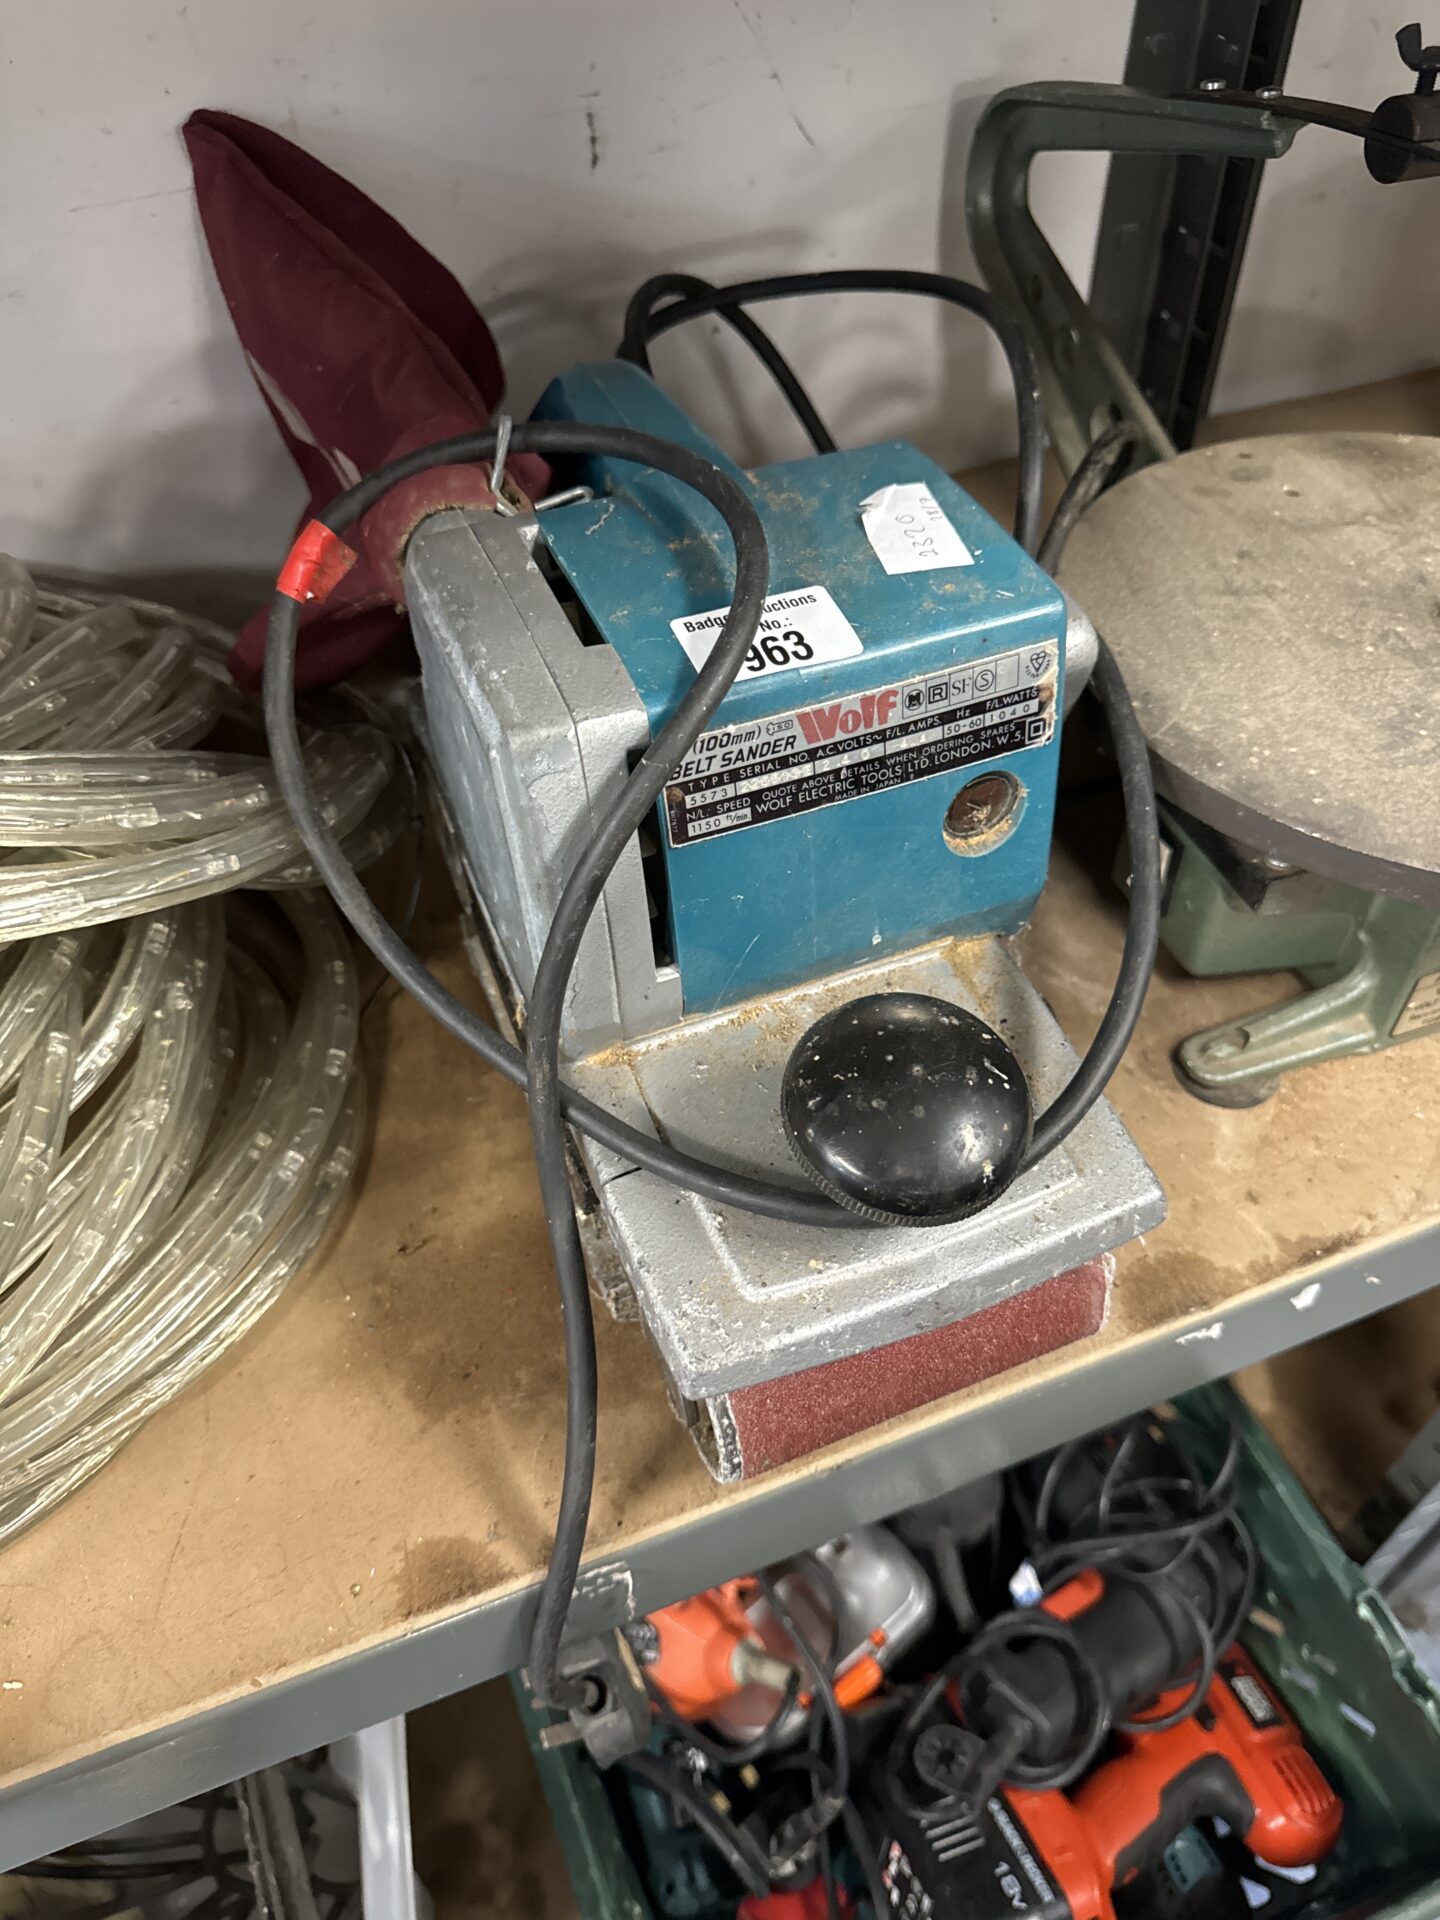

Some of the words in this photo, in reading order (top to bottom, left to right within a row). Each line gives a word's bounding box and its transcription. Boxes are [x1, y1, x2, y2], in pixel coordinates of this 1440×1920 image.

[763, 593, 817, 613] uctions
[743, 630, 814, 672] 963
[796, 689, 899, 745] Wolf
[956, 707, 971, 719] Hz
[989, 704, 1030, 723] 1040
[946, 718, 982, 735] 50-60
[692, 725, 762, 755] (100mm)
[670, 754, 716, 781] BELT
[720, 735, 797, 768] SANDER
[739, 759, 781, 779] SERIAL
[788, 752, 811, 765] NO.
[762, 785, 797, 801] QUOTE
[802, 773, 835, 790] ABOVE
[841, 761, 880, 779] DETAILS
[886, 751, 917, 766] WHEN
[922, 734, 974, 756] ORDERING
[980, 722, 1016, 740] SPARES
[688, 773, 731, 792] TYPE
[755, 796, 793, 813] WOLF
[799, 778, 855, 803] ELECTRIC
[861, 765, 902, 785] TOOLS
[908, 759, 932, 773] LTD.
[934, 740, 995, 765] LONDON.
[690, 788, 728, 806] 5573
[834, 790, 858, 801] MADE
[860, 786, 870, 794] IN
[875, 778, 901, 791] JAPAN
[716, 797, 751, 814] SPEED
[691, 818, 721, 834] 1150
